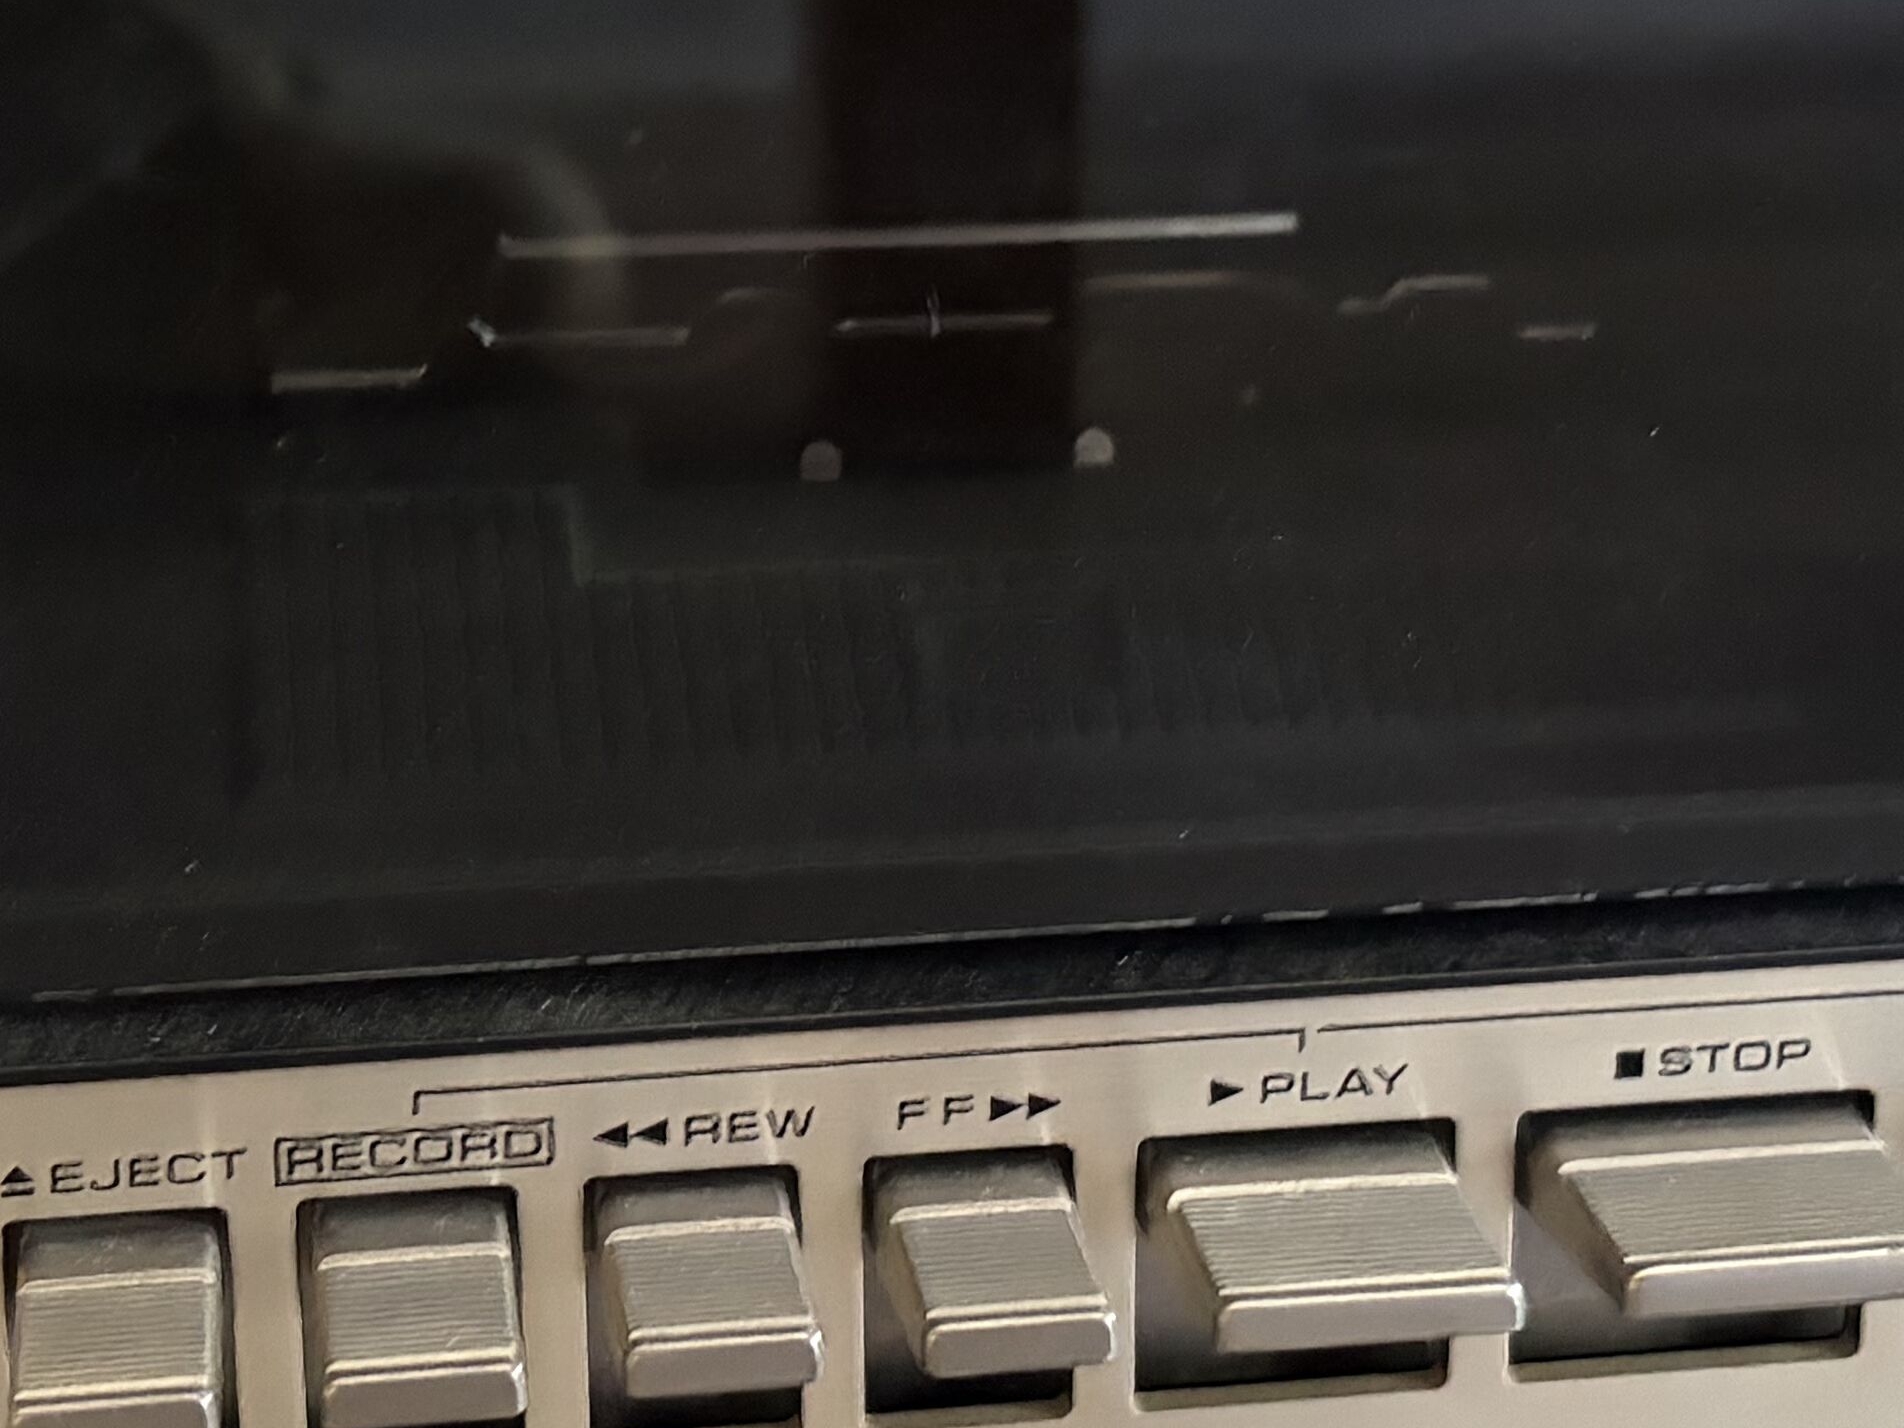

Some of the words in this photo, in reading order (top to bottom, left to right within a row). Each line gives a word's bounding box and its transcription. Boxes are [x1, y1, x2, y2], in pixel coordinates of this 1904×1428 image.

[1658, 1036, 1812, 1078] STOP
[1258, 1062, 1410, 1106] PLAY
[684, 1104, 818, 1148] REW
[896, 1092, 976, 1132] FF
[286, 1126, 546, 1168] RECORD
[48, 1146, 248, 1196] EJECT
